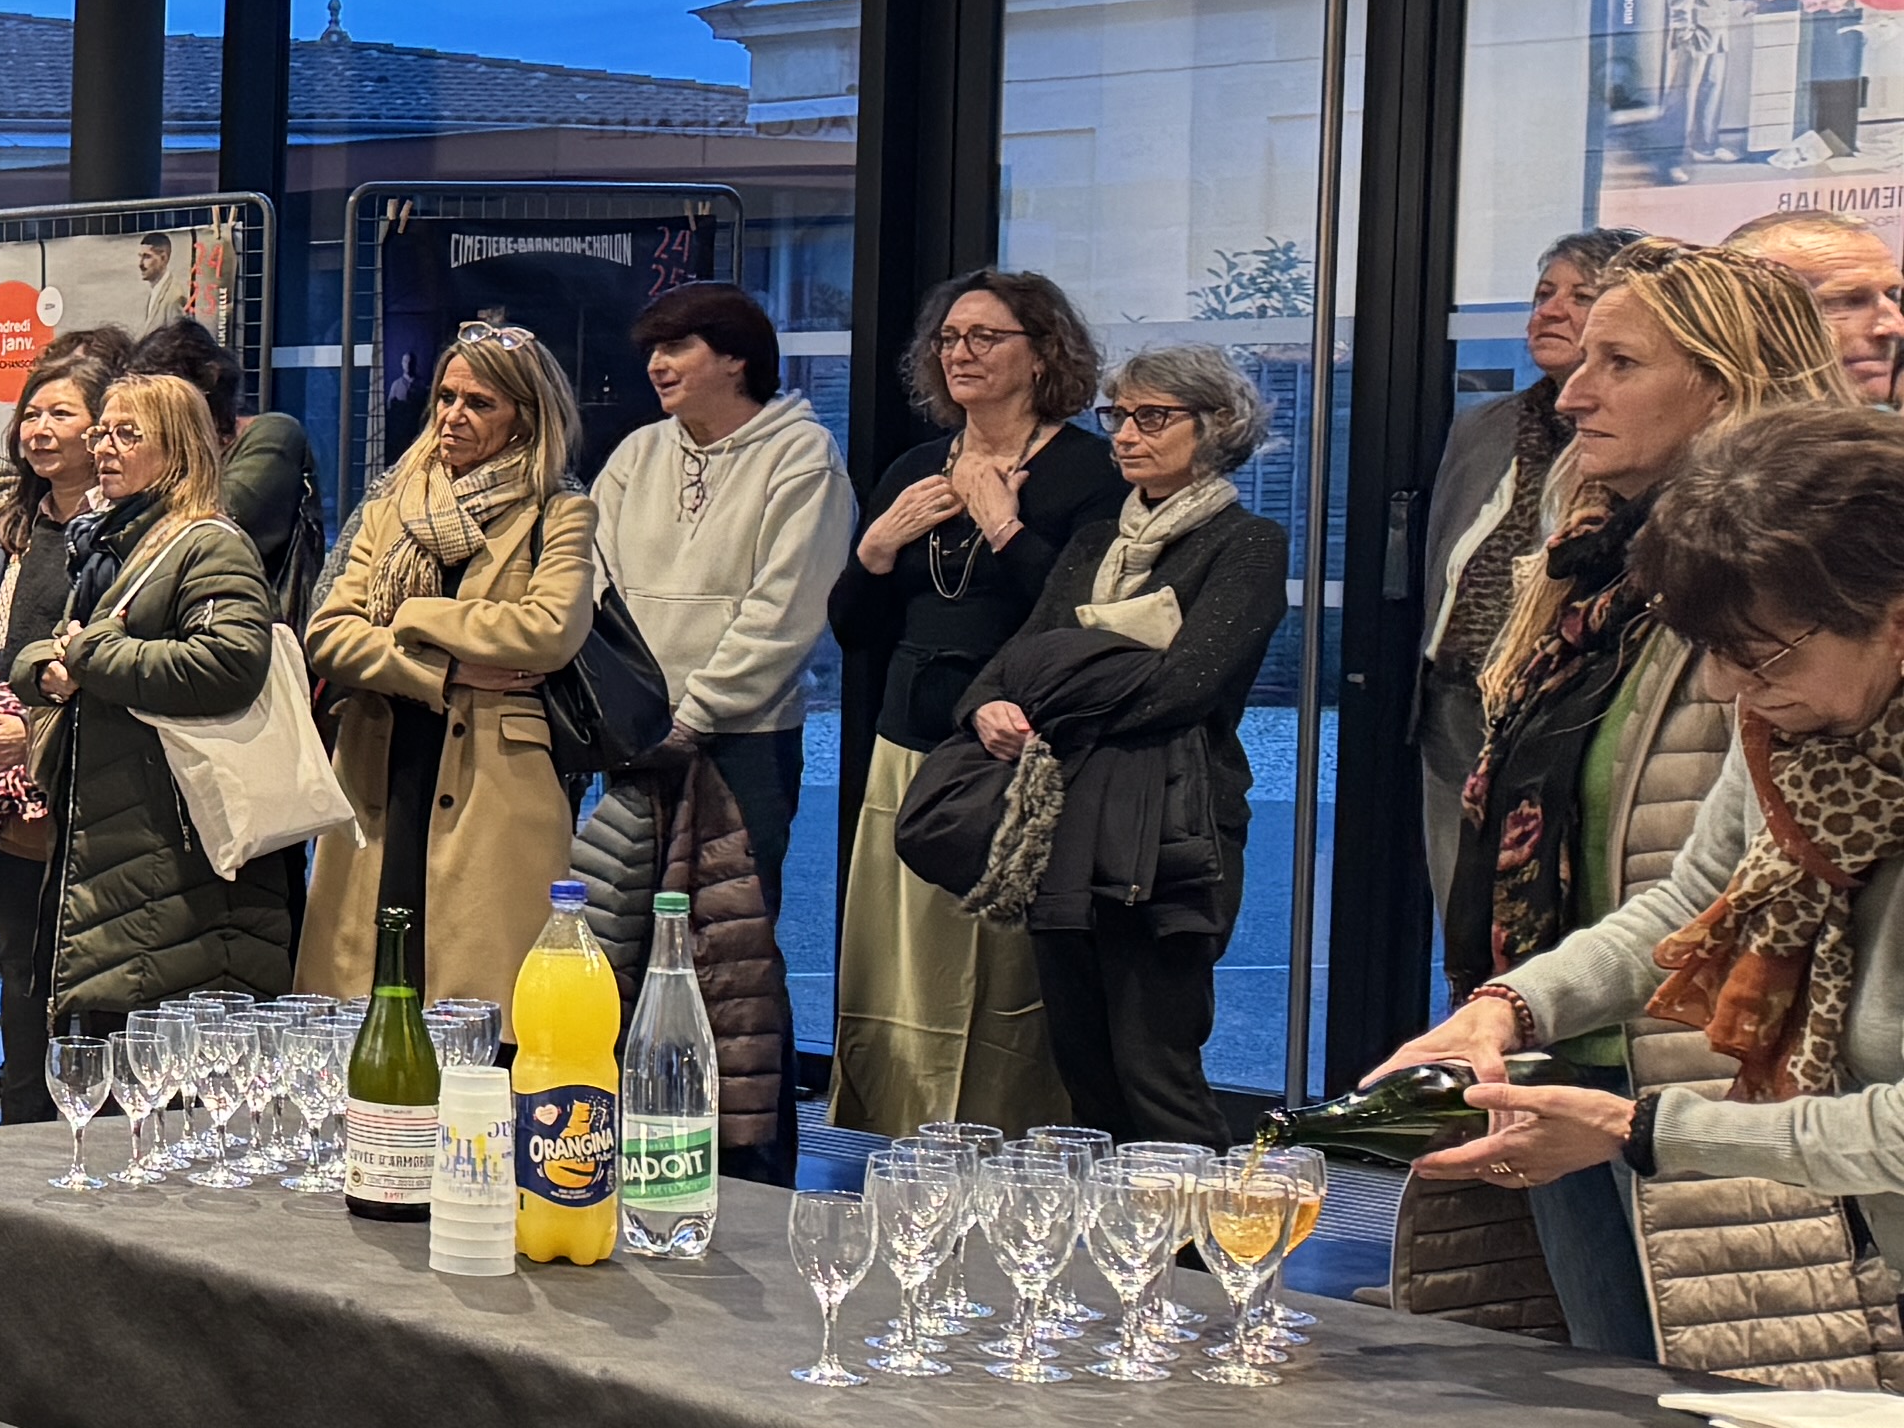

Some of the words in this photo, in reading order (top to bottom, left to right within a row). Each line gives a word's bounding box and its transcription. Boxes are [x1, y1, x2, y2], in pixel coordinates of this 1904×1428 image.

[189, 242, 225, 279] 24
[654, 226, 691, 263] 24
[182, 280, 218, 316] 25
[0, 334, 36, 357] janv.
[529, 1127, 615, 1164] ORANGINA
[622, 1149, 704, 1182] BADOIT
